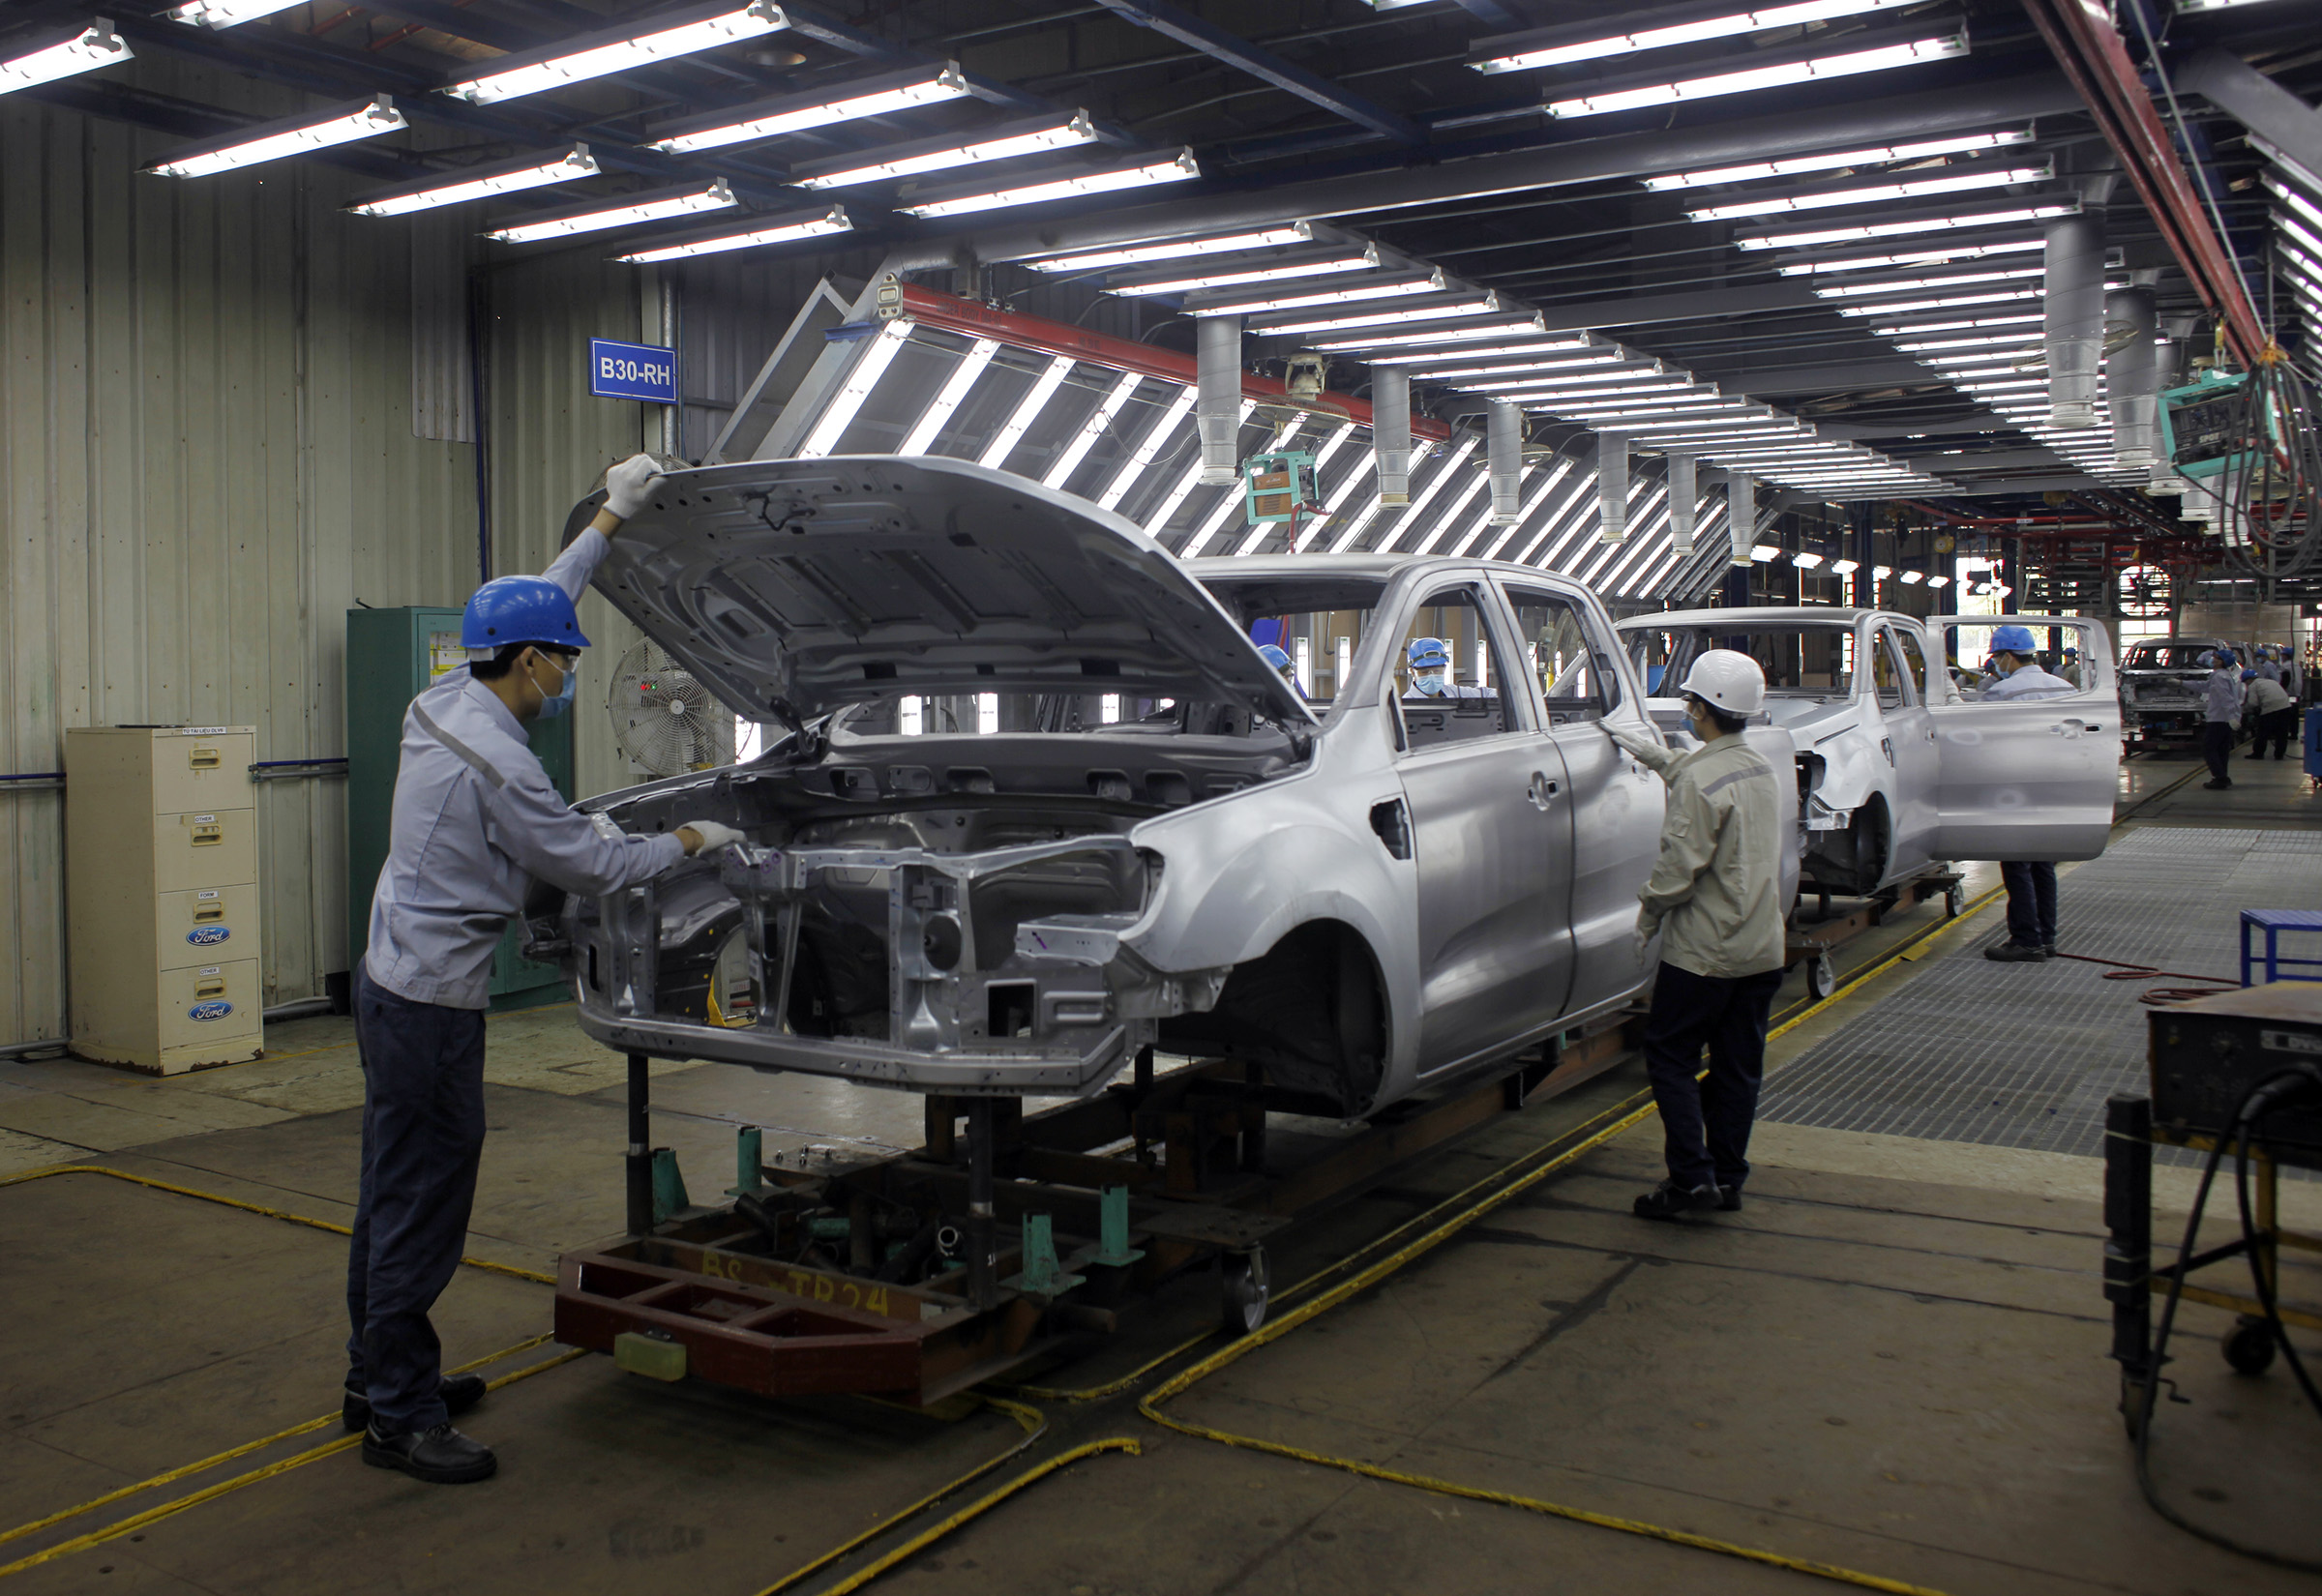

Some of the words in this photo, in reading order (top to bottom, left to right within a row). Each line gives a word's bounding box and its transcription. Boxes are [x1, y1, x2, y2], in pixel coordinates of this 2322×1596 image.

[600, 357, 670, 386] B30-RH
[194, 928, 223, 943] Ford
[196, 1004, 225, 1019] Ford
